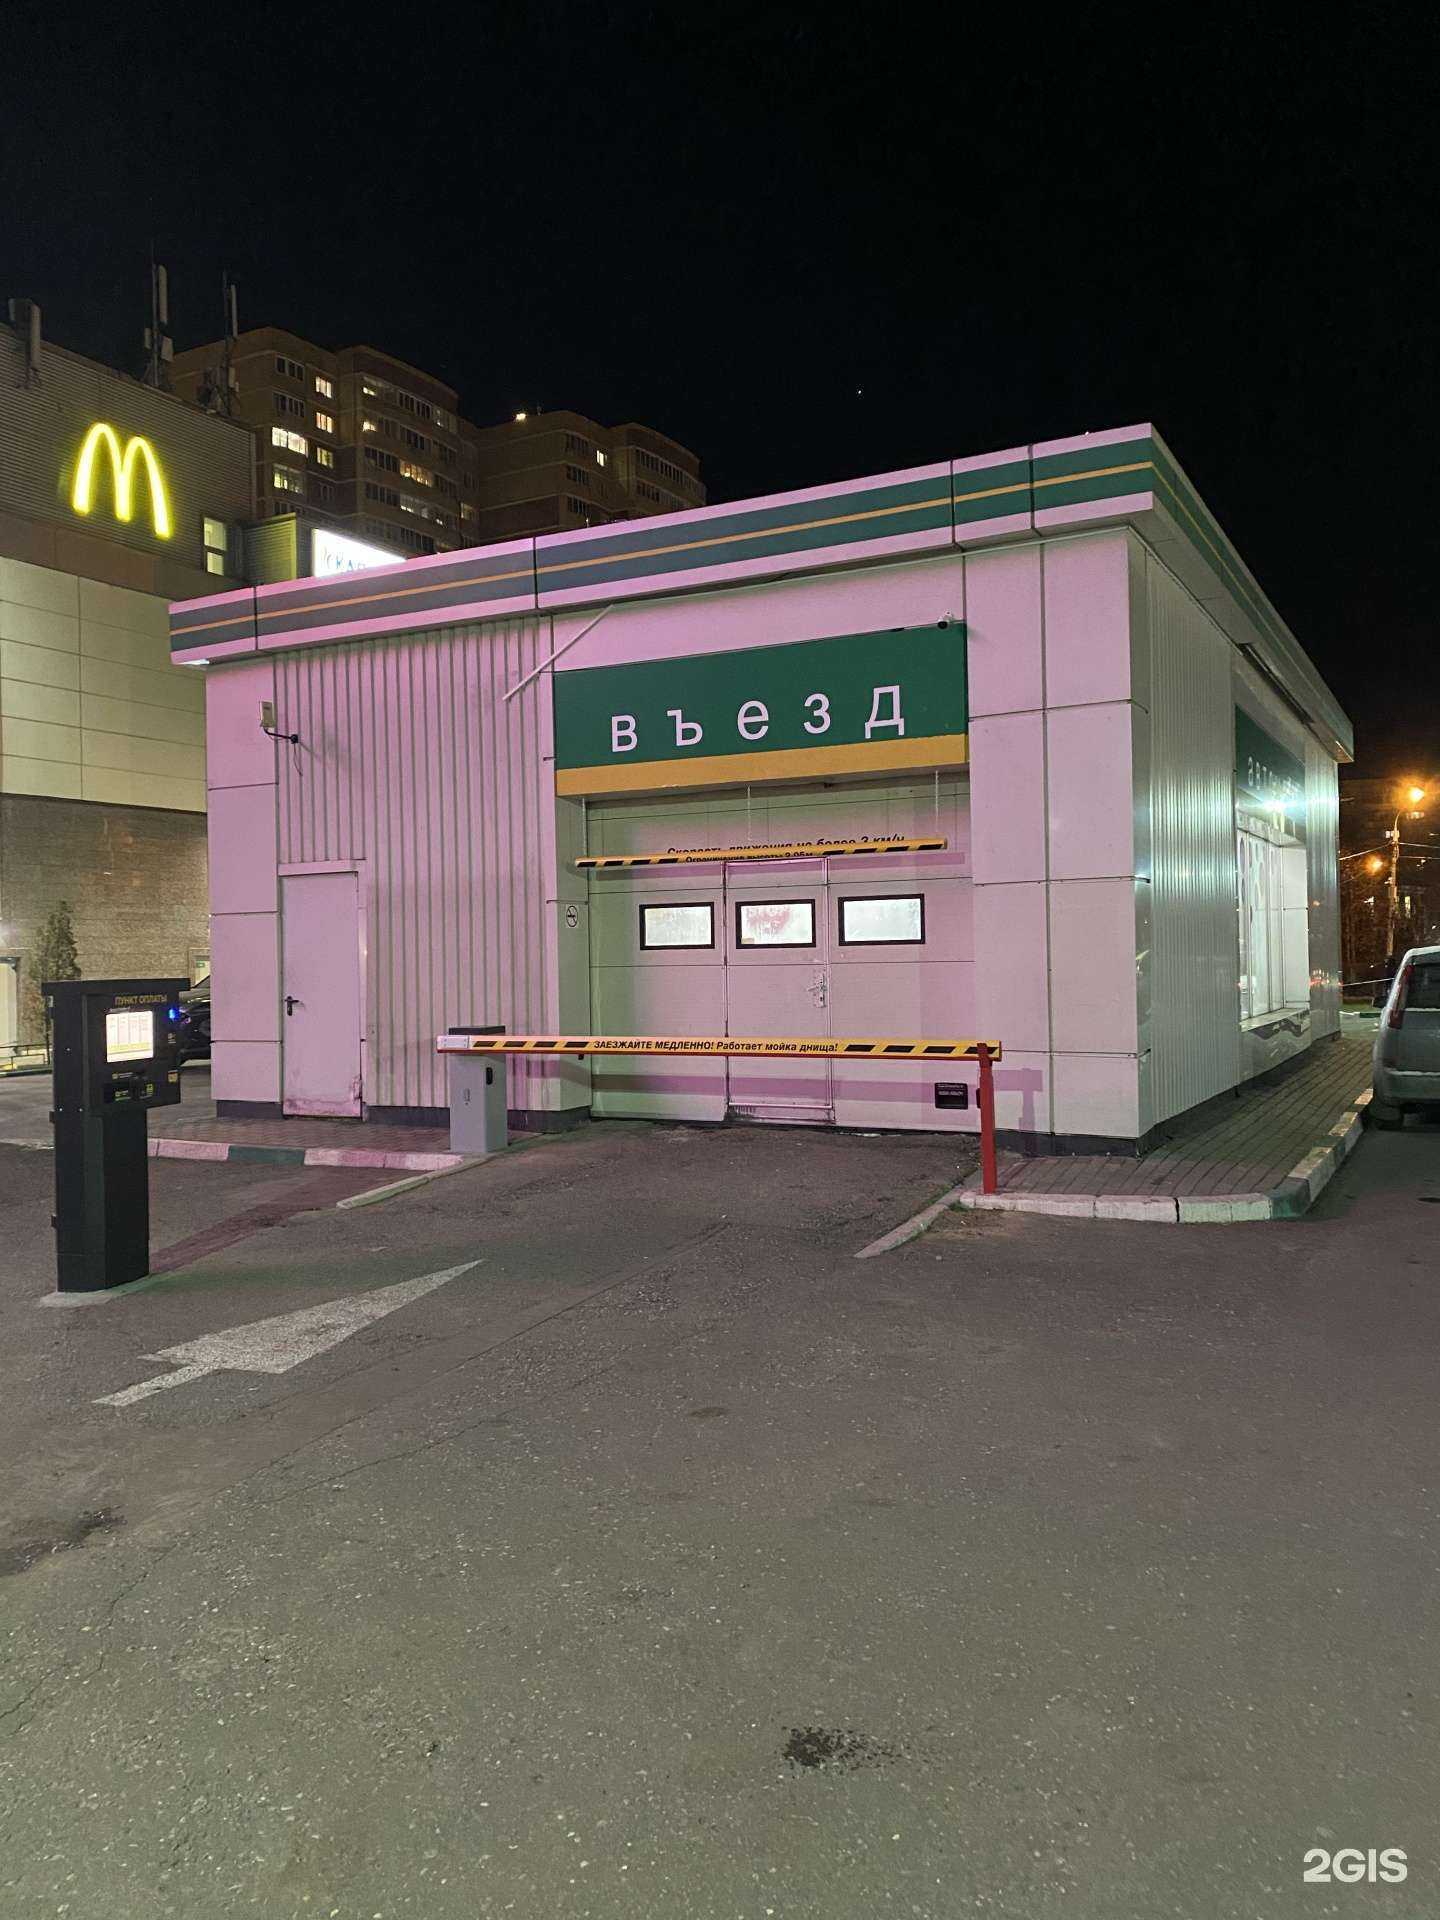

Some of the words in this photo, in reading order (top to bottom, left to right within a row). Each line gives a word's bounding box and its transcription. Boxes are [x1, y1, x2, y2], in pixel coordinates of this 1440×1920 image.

[593, 1040, 652, 1049] ЗАЕЗЖАЙТЕ
[654, 1041, 714, 1051] МЕДЛЕННО!
[716, 1041, 763, 1050] Работает
[765, 1042, 797, 1051] мойка
[799, 1043, 839, 1052] днища!
